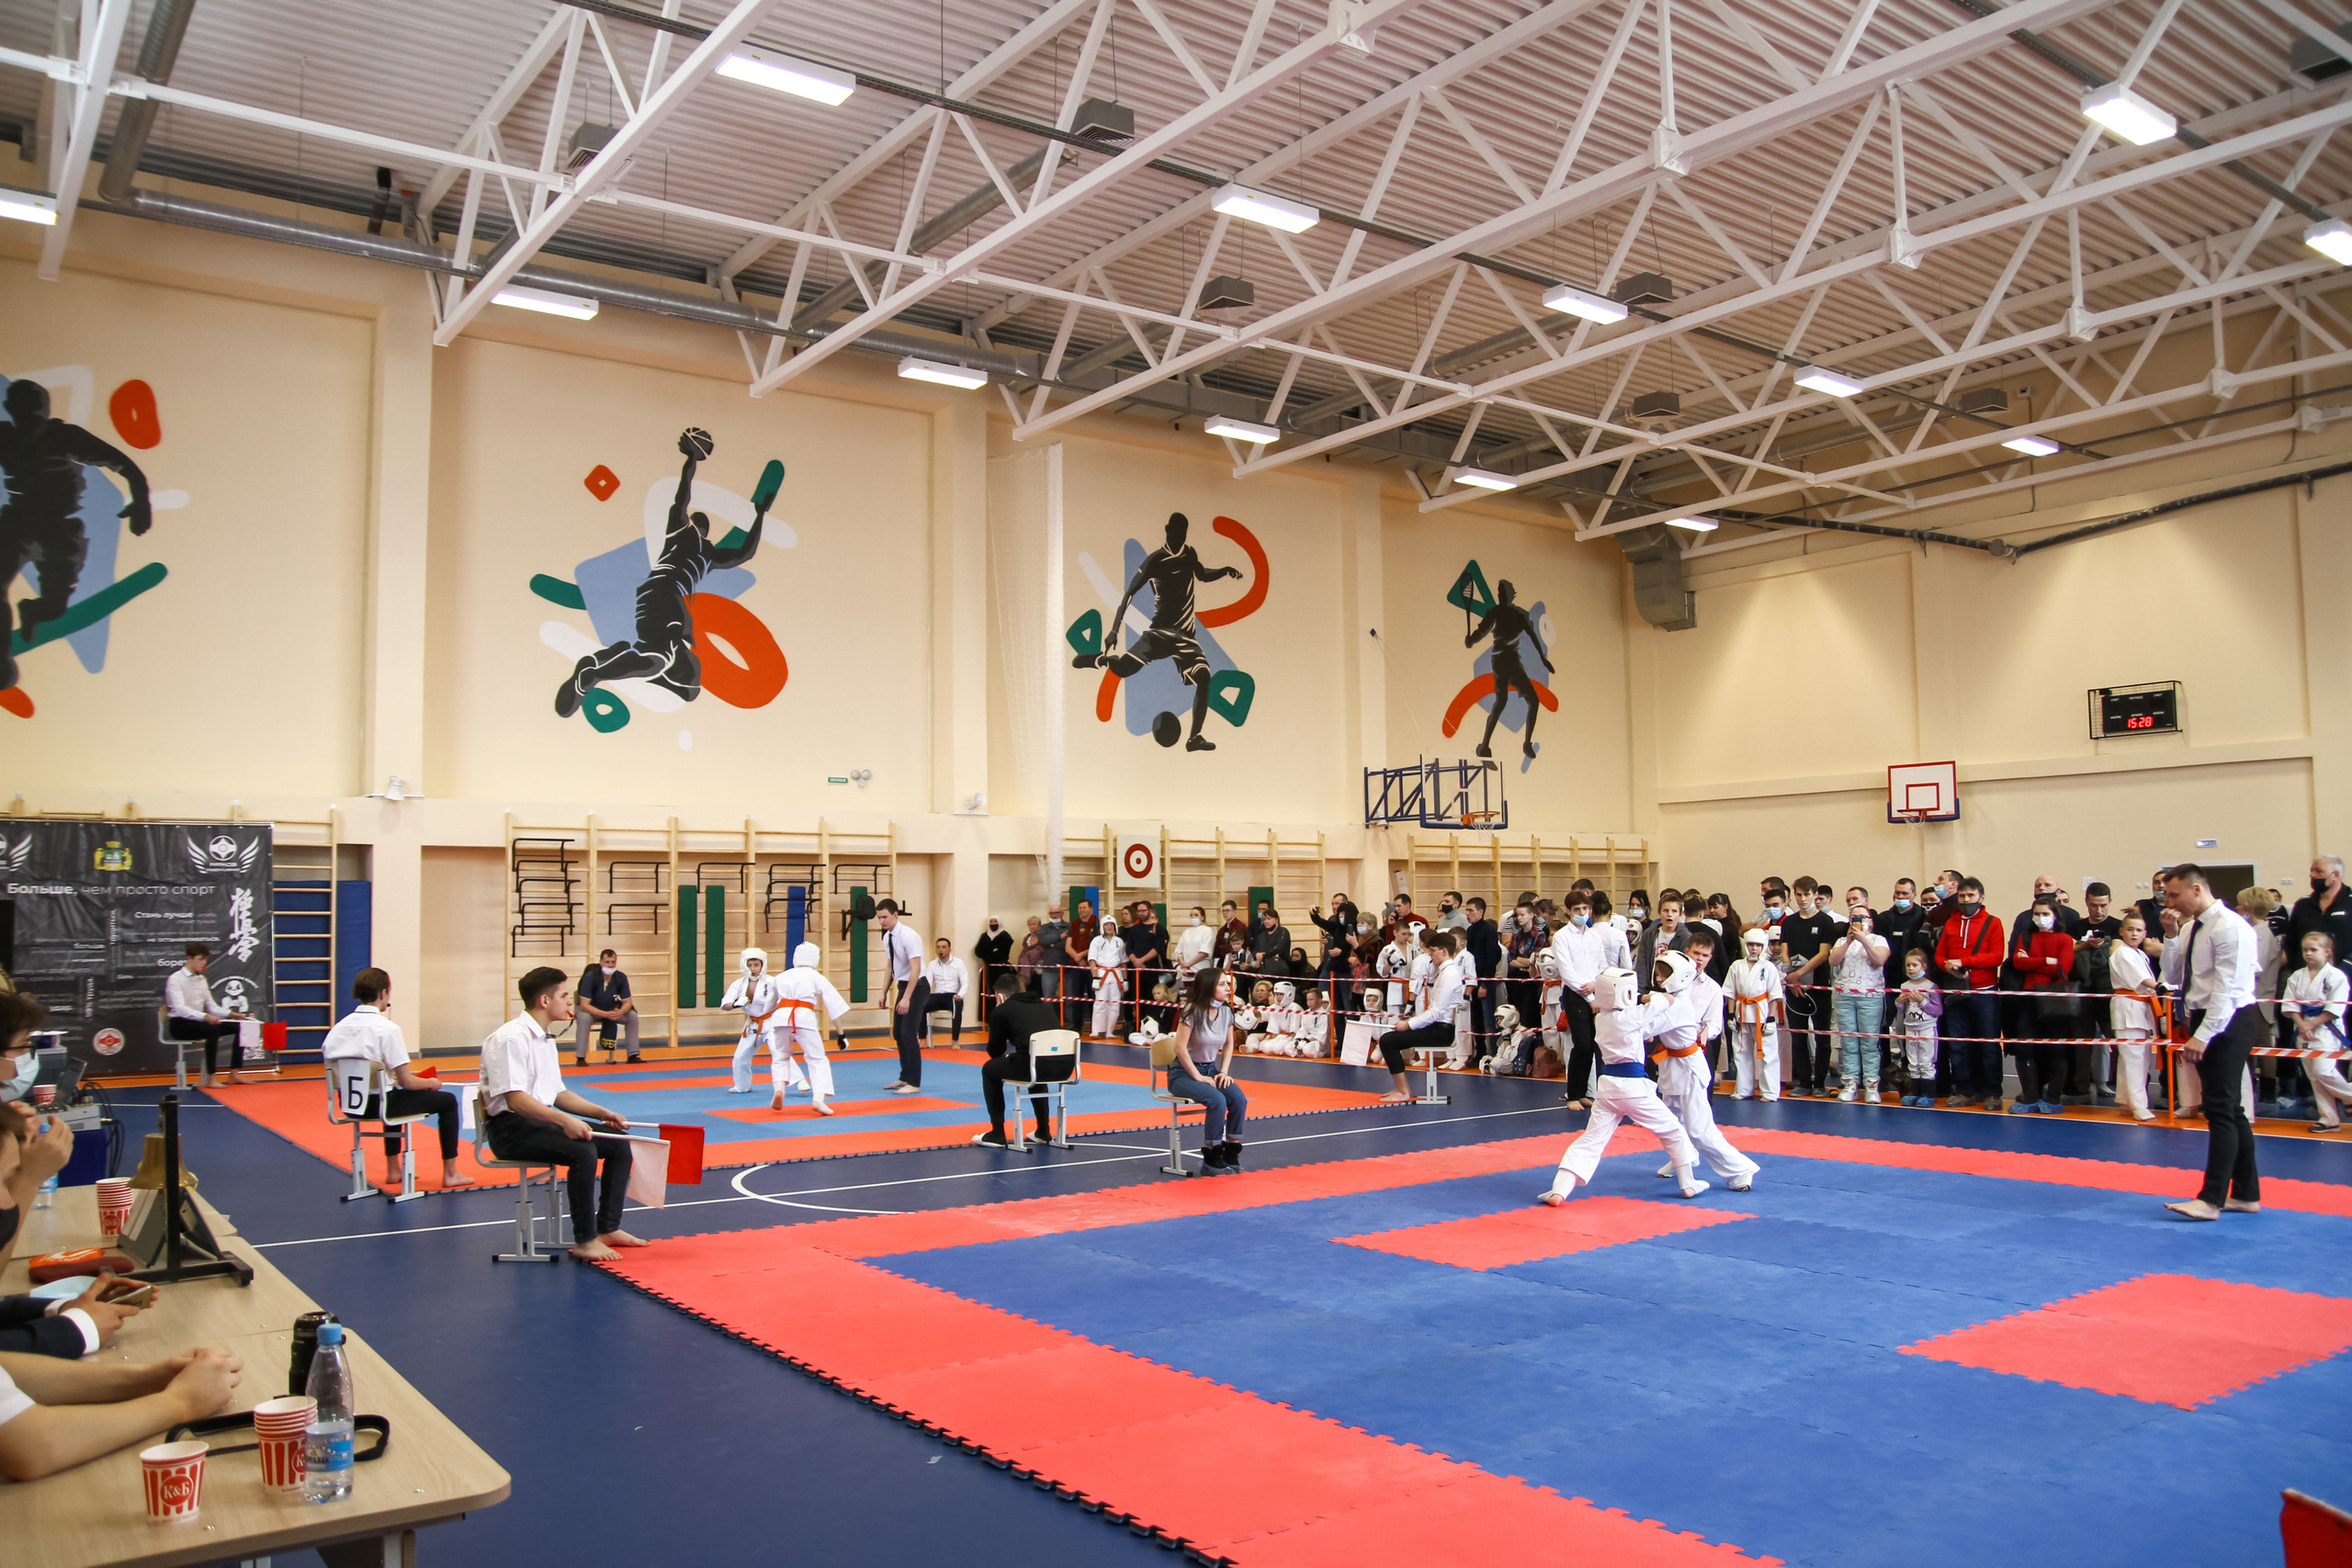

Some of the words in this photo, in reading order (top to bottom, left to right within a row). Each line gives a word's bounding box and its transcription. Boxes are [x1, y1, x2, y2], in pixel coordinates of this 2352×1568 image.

[6, 883, 78, 897] Больше,
[81, 886, 111, 895] чем
[116, 886, 169, 897] просто
[172, 886, 216, 897] спорт
[348, 1076, 363, 1109] Б
